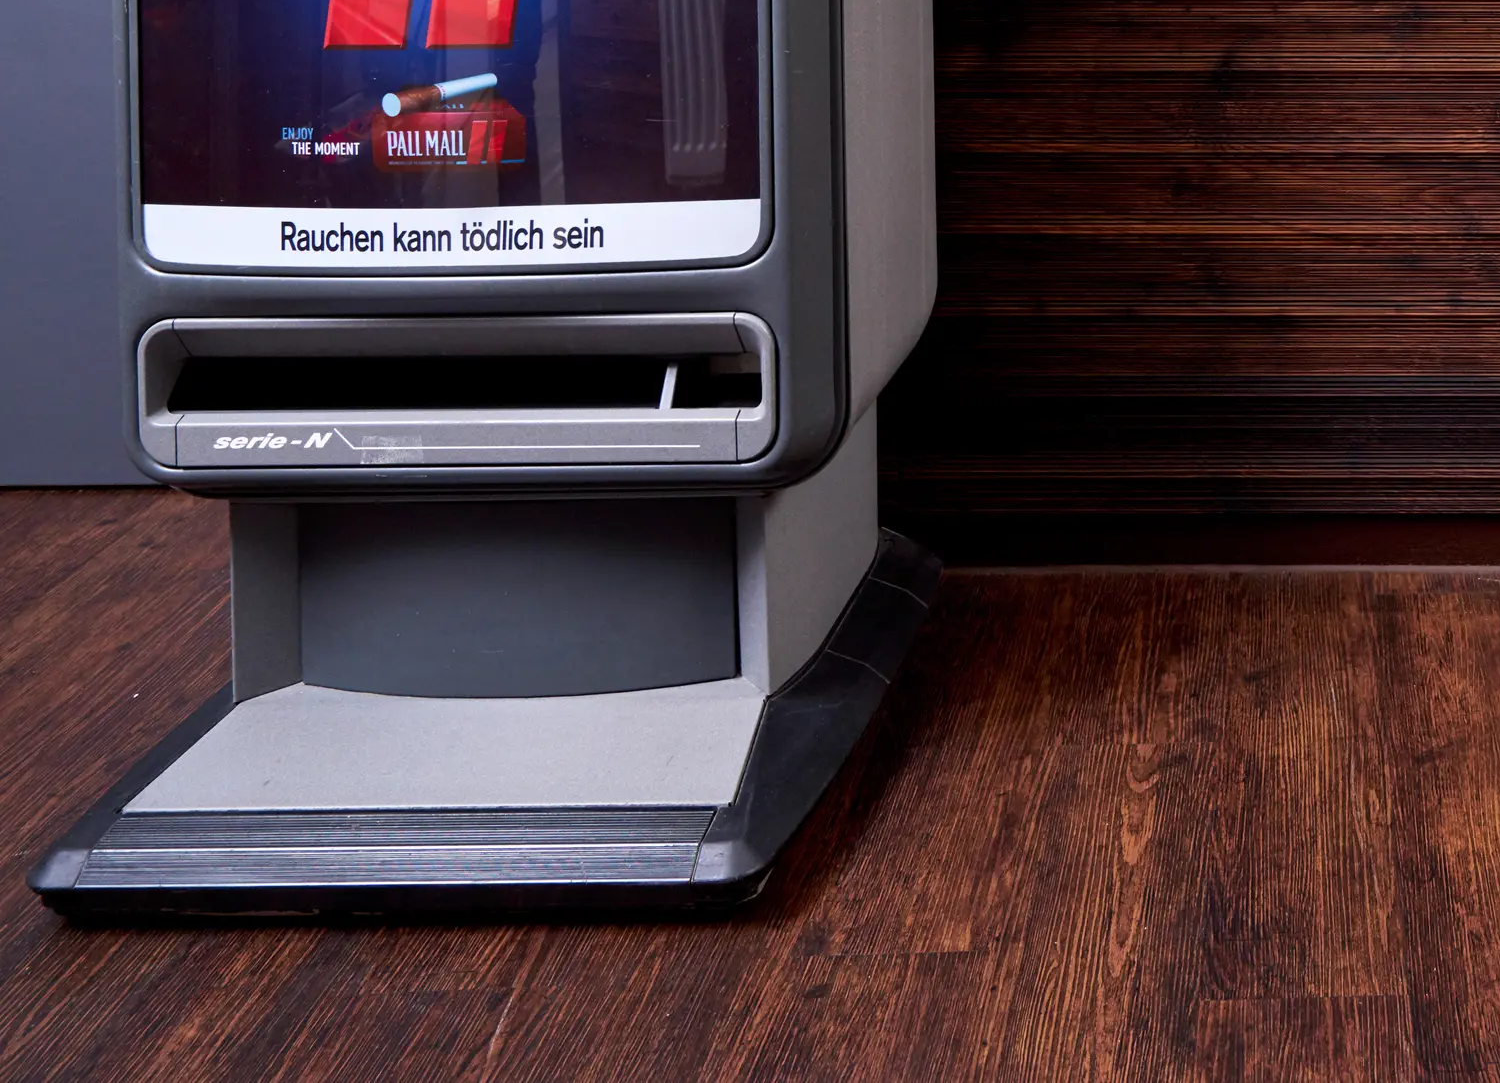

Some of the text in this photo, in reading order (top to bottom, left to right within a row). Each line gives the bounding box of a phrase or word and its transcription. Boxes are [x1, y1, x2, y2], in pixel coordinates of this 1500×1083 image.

[282, 127, 313, 140] ENJOY
[387, 130, 466, 157] PALL MALL
[292, 142, 360, 155] THE MOMENT
[280, 219, 604, 252] Rauchen kann tödlich sein
